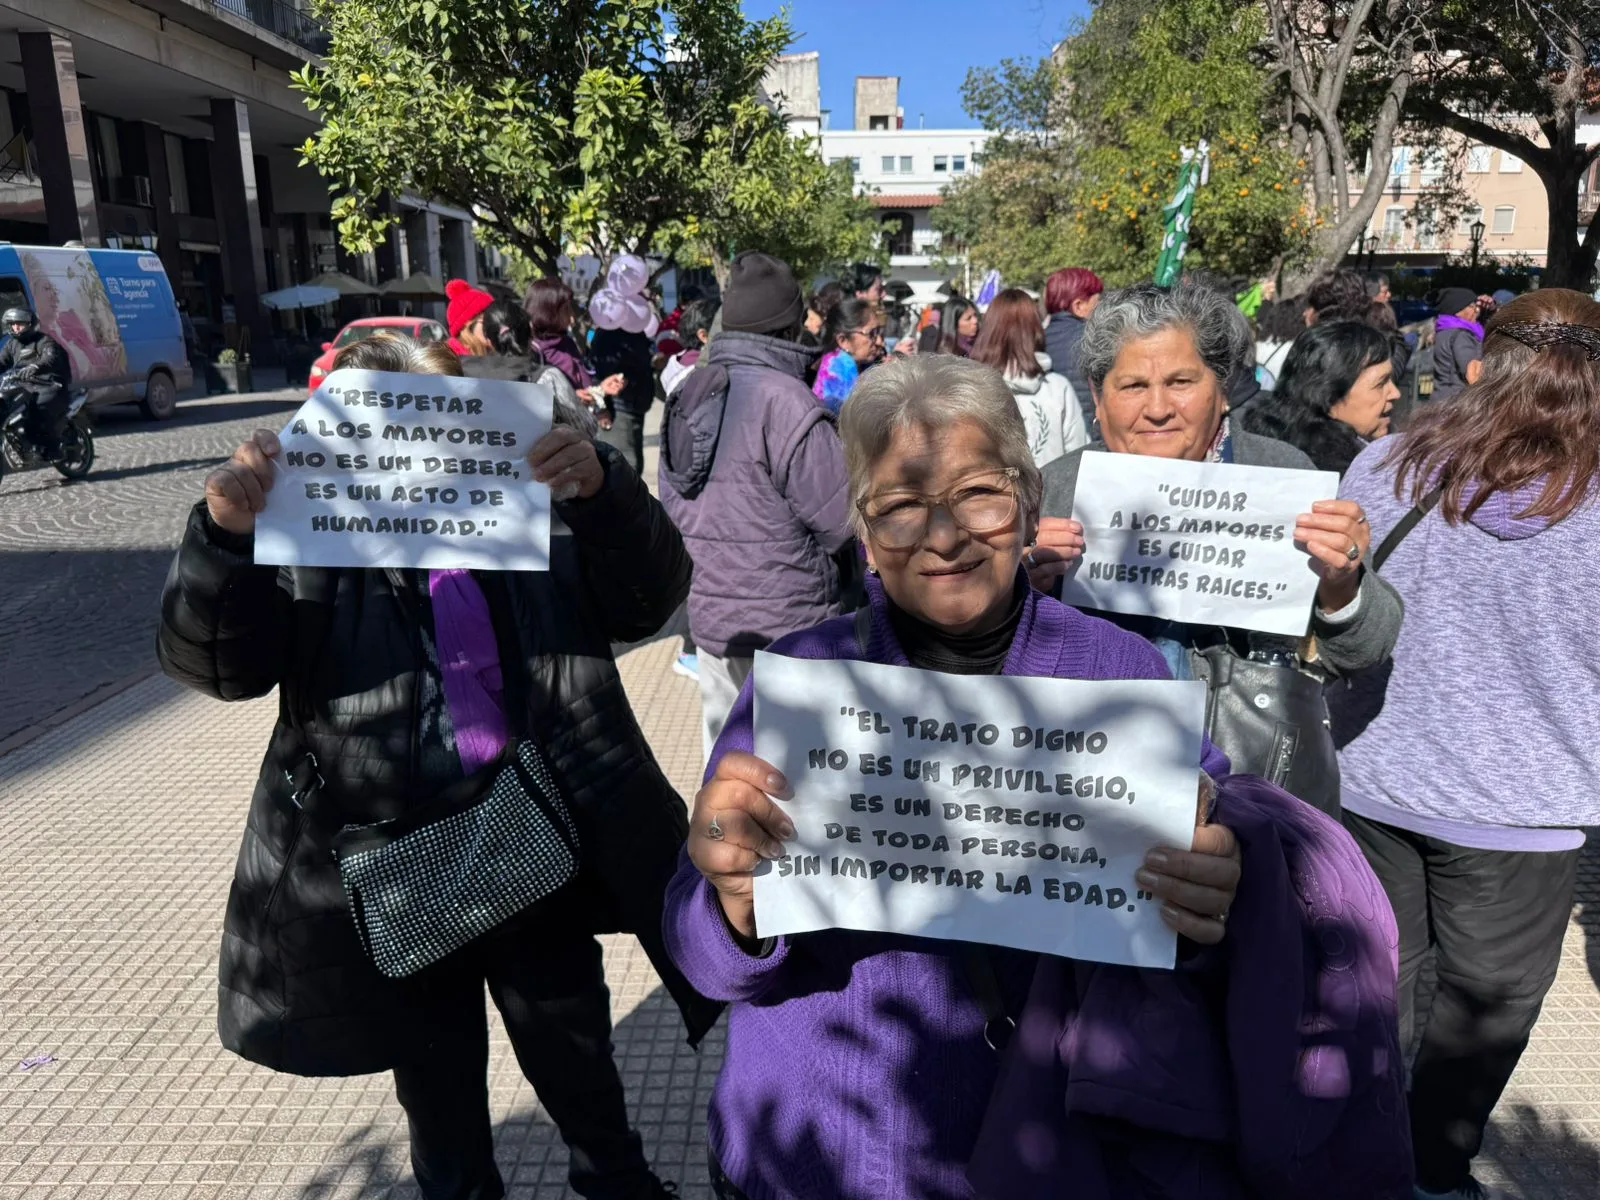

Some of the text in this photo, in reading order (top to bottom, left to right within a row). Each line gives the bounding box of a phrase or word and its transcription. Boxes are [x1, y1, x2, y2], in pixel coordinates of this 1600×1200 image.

[328, 387, 484, 416] "RESPETAR
[291, 418, 517, 447] A LOS MAYORES
[286, 451, 520, 480] NO ES UN DEBER,
[304, 482, 505, 506] ES UN ACTO DE
[1158, 483, 1248, 512] "CUIDAR
[311, 514, 498, 537] HUMANIDAD."
[1109, 510, 1285, 542] A LOS MAYORES
[1137, 538, 1246, 569] ES CUIDAR
[1089, 561, 1287, 601] NUESTRAS RAICES."
[840, 706, 1108, 755] "EL TRATO DIGNO
[808, 748, 1136, 805] NO ES UN PRIVILEGIO,
[849, 793, 1085, 832] ES UN DERECHO
[824, 822, 1107, 869] DE TODA PERSONA,
[777, 854, 1153, 912] SIN IMPORTAR LA EDAD."
